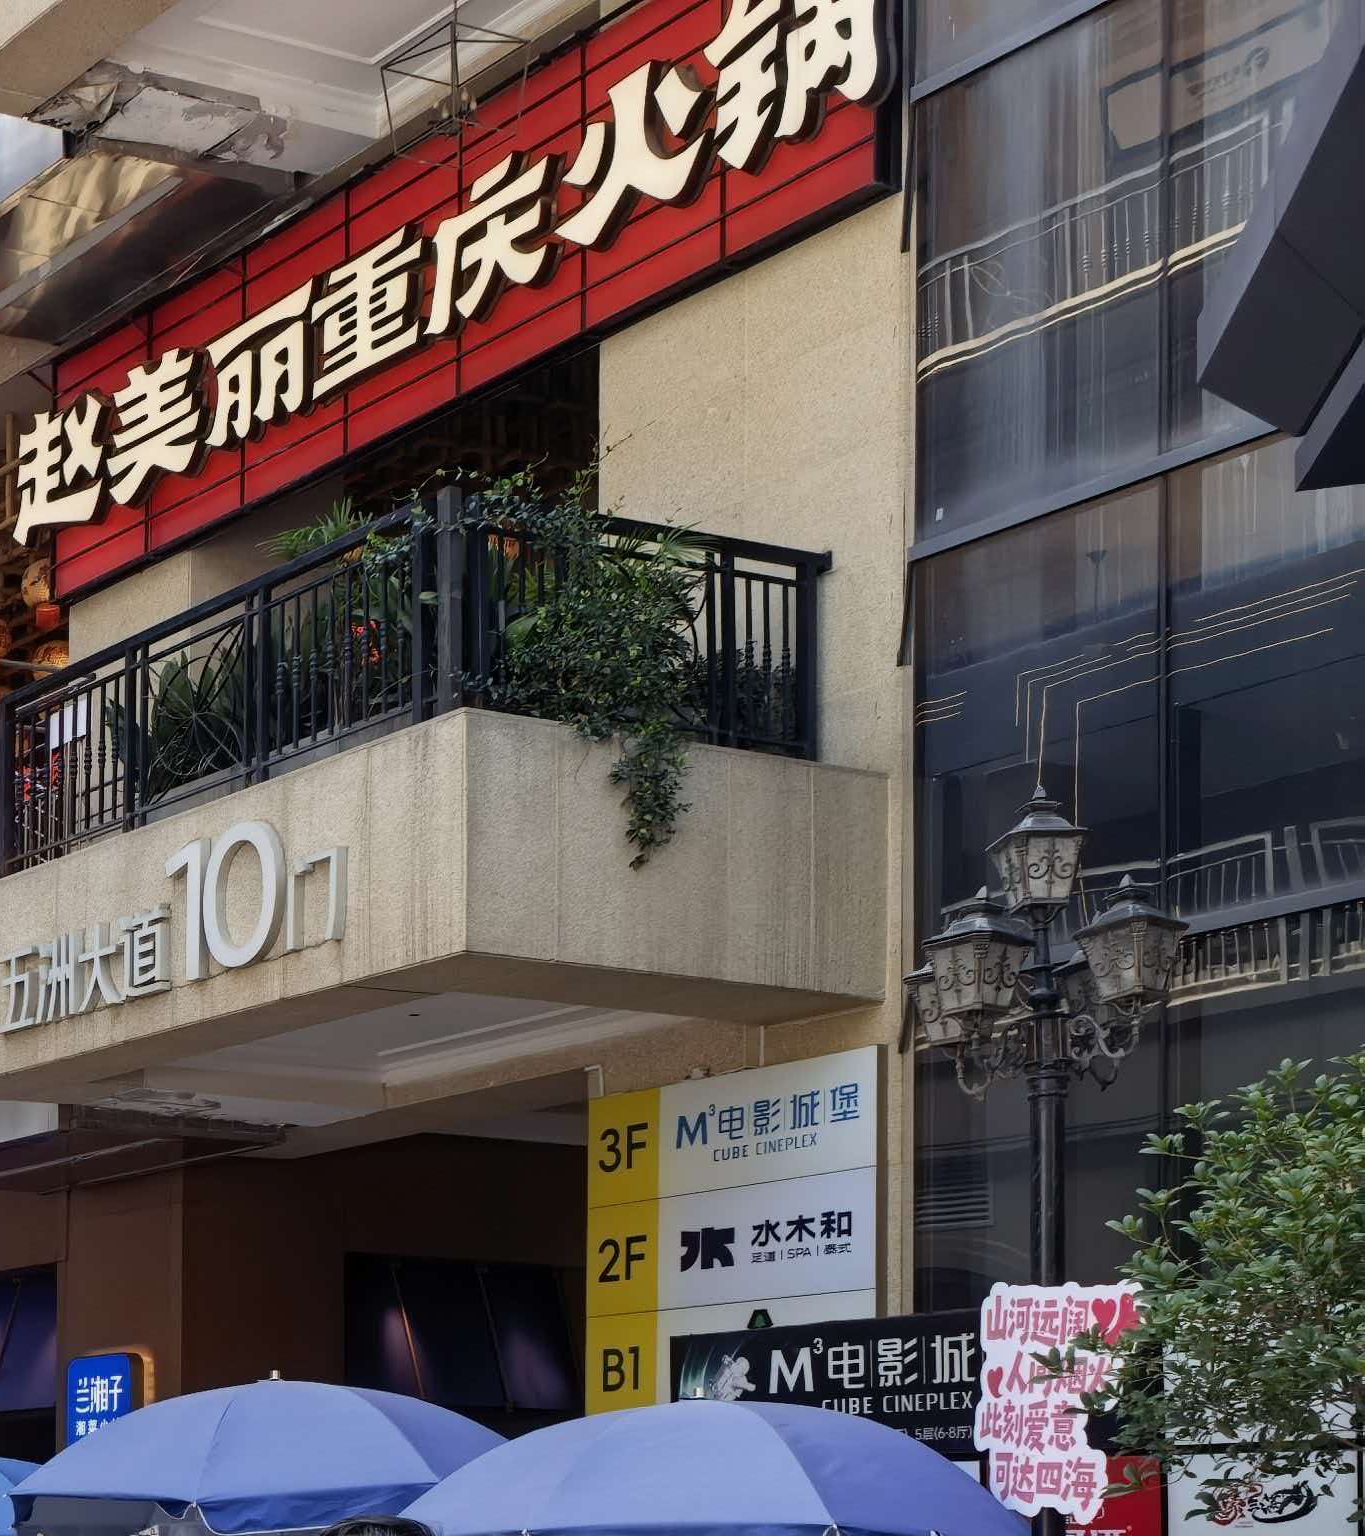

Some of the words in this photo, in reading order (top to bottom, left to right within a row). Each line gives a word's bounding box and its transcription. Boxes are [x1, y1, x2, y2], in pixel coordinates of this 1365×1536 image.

[16, 0, 879, 546] 赵美丽重庆火锅
[598, 1122, 649, 1172] 3F
[713, 1144, 749, 1162] CUBE
[756, 1133, 818, 1155] CINEPLEX
[751, 1211, 852, 1247] 水木和
[787, 1247, 812, 1259] SPA
[597, 1234, 647, 1283] 2F
[986, 1295, 1089, 1346] 山河远阔
[602, 1345, 640, 1392] B1
[76, 1376, 122, 1413] 兰湘子
[883, 1391, 973, 1414] CINEPLEX
[980, 1399, 1077, 1454] 此刻爱意
[996, 1452, 1097, 1511] 可达四海
